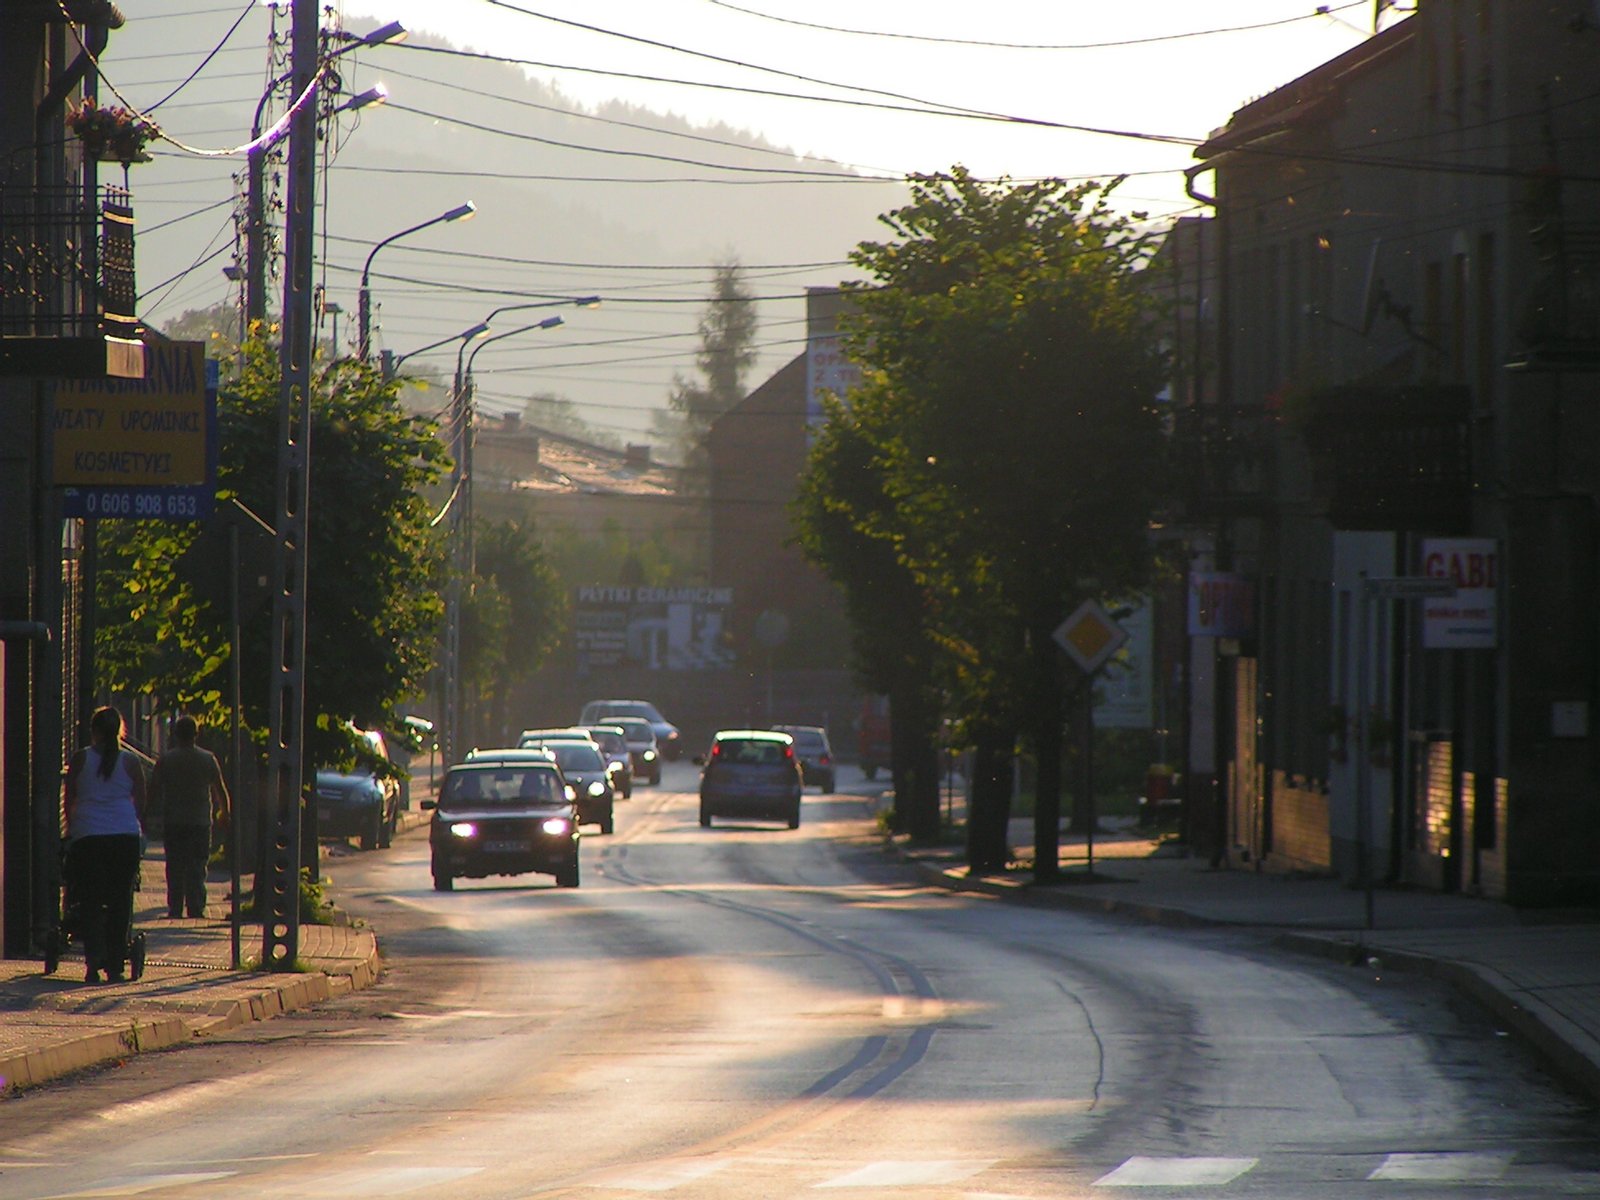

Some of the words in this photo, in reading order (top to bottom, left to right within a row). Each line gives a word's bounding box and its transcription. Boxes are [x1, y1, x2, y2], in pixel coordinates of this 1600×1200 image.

[121, 410, 200, 432] UPOMINKI
[74, 451, 171, 473] KOSMETYKI
[87, 493, 96, 513] 0
[101, 493, 129, 514] 606
[135, 494, 162, 515] 908
[167, 495, 196, 516] 653
[636, 587, 734, 604] CERAMICZNE
